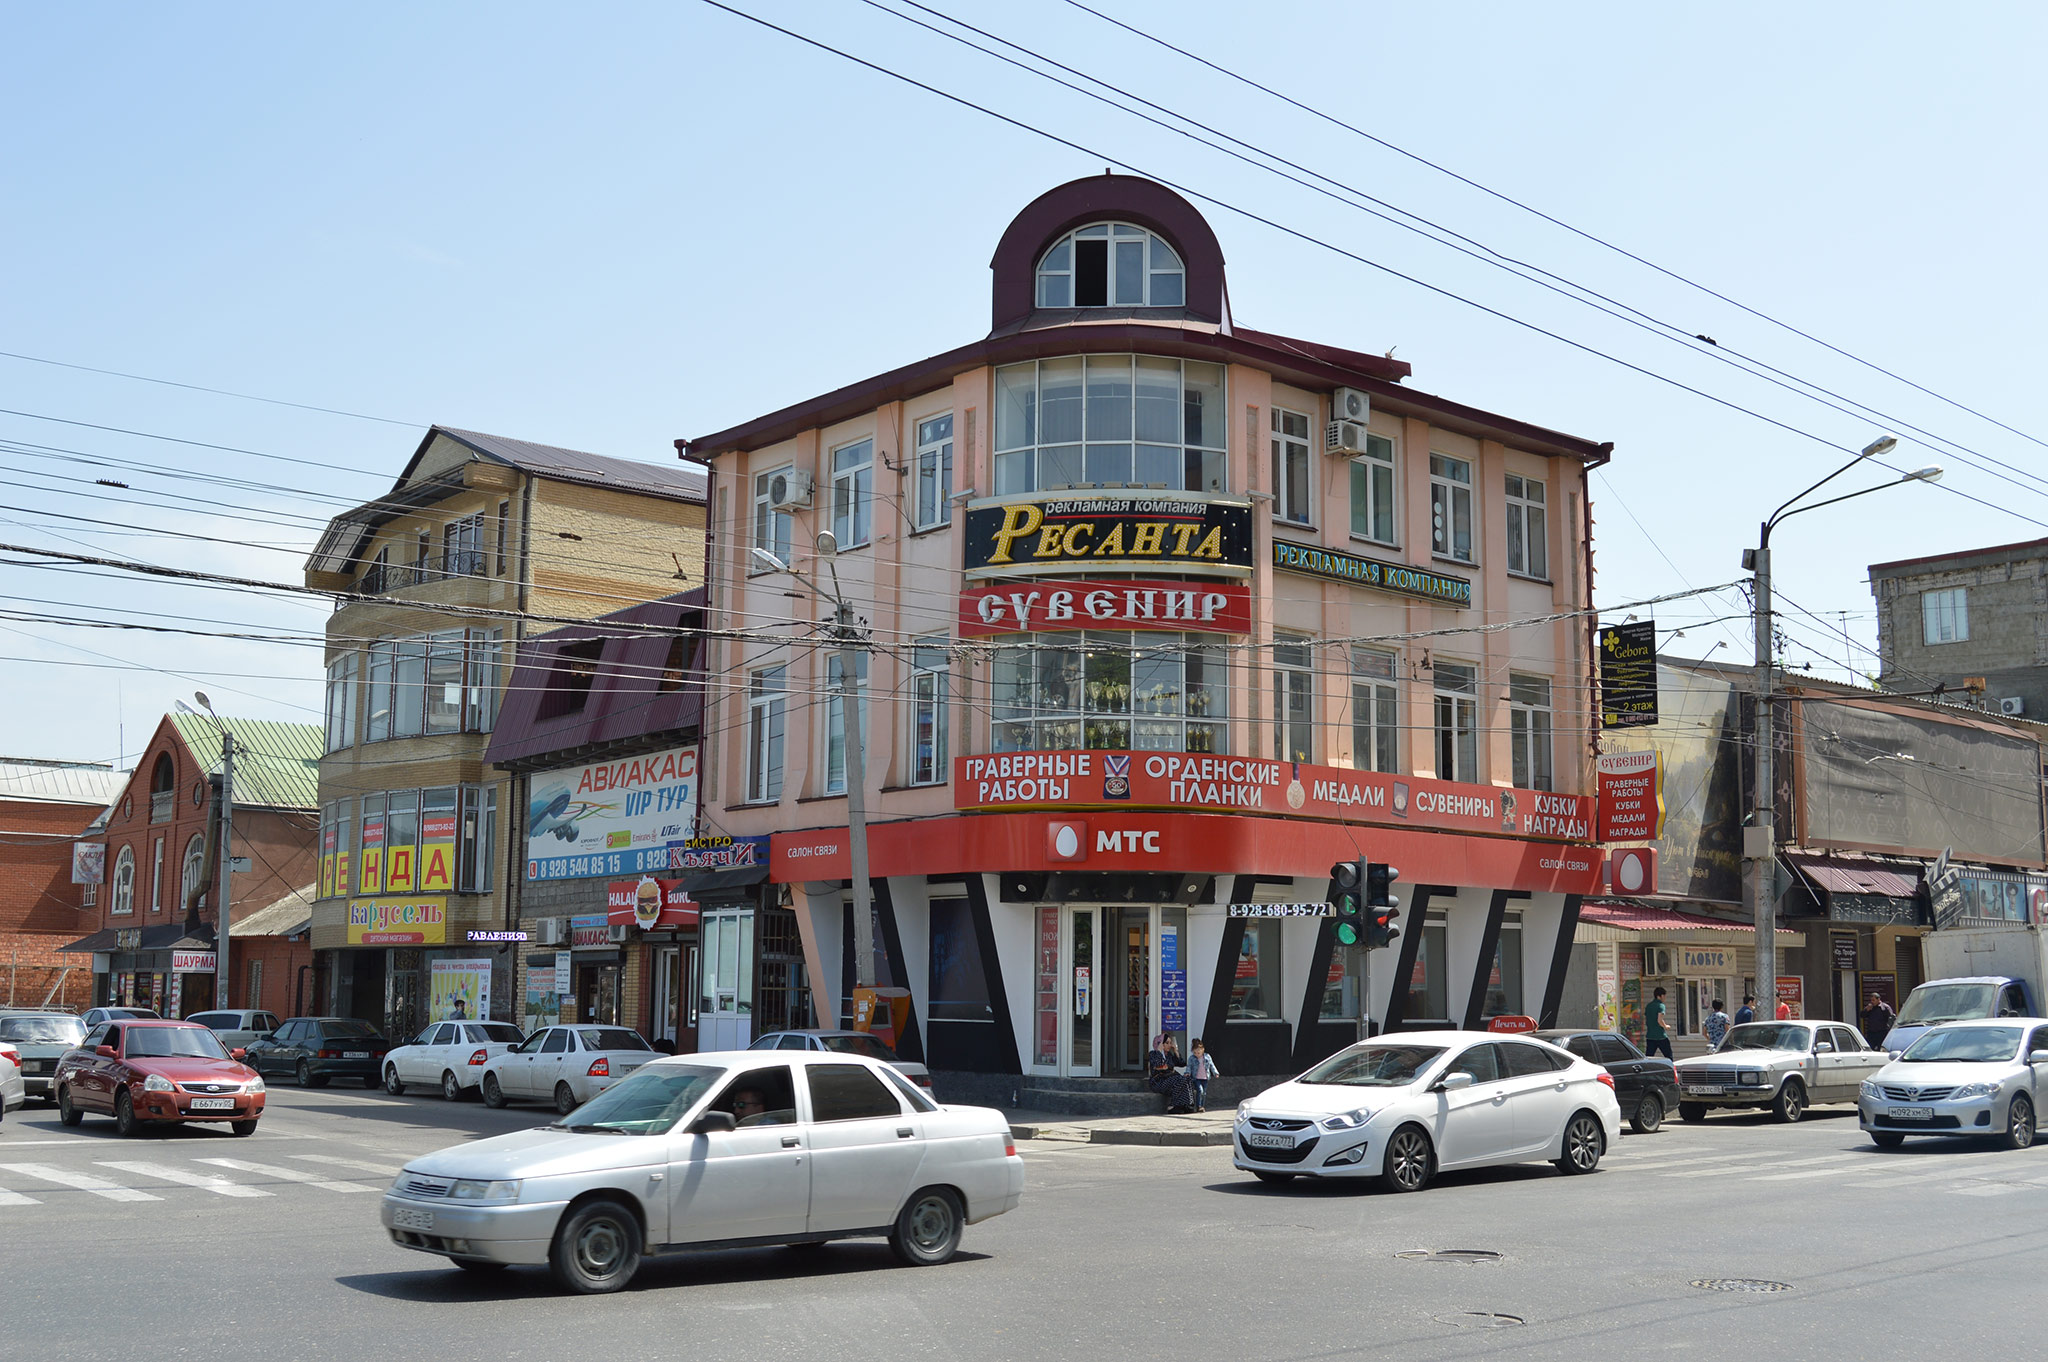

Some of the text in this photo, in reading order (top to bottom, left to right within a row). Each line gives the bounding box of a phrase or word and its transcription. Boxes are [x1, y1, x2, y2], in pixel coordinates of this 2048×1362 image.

[1045, 500, 1207, 517] рекламная компания
[1275, 544, 1471, 601] РЕКЛАМНАЯ КОМПАНИЯ
[1615, 643, 1649, 659] Gebora
[1623, 702, 1629, 712] 2
[1632, 702, 1654, 711] этаж
[577, 751, 698, 794] АВИАКАС
[965, 754, 1091, 781] ГРАВЕРНЫЕ
[1145, 756, 1280, 786] ОРДЕНСКИЕ
[978, 778, 1069, 802] РАБОТЫ
[1606, 777, 1649, 789] ГРАВЕРНЫЕ
[1612, 788, 1643, 797] РАБОТЫ
[625, 785, 689, 817] VIP ТУР
[1170, 781, 1263, 807] ПЛАНКИ
[1312, 780, 1385, 808] МЕДАЛИ
[1416, 791, 1495, 818] СУВЕНИРЫ
[1534, 794, 1577, 816] КУБКИ
[1615, 801, 1641, 810] КУБКИ
[1523, 814, 1588, 839] НАГРАДЫ
[1611, 813, 1645, 823] МЕДАЛИ
[1096, 830, 1161, 853] МТС
[1609, 827, 1648, 837] НАГРАДЫ
[685, 836, 732, 848] БИСТРО
[787, 844, 837, 858] салон связи
[541, 854, 621, 877] 8 928 544 85 15
[637, 849, 667, 870] 8 928
[1539, 857, 1589, 872] салон связи
[318, 849, 449, 893] РЕНДА
[350, 902, 444, 931] карусель
[1230, 904, 1327, 917] 8-928-680-95-72
[370, 934, 389, 942] детский
[174, 955, 215, 968] ШАУРМА
[1685, 951, 1724, 966] ГЛОБУС
[1076, 969, 1089, 977] 0%
